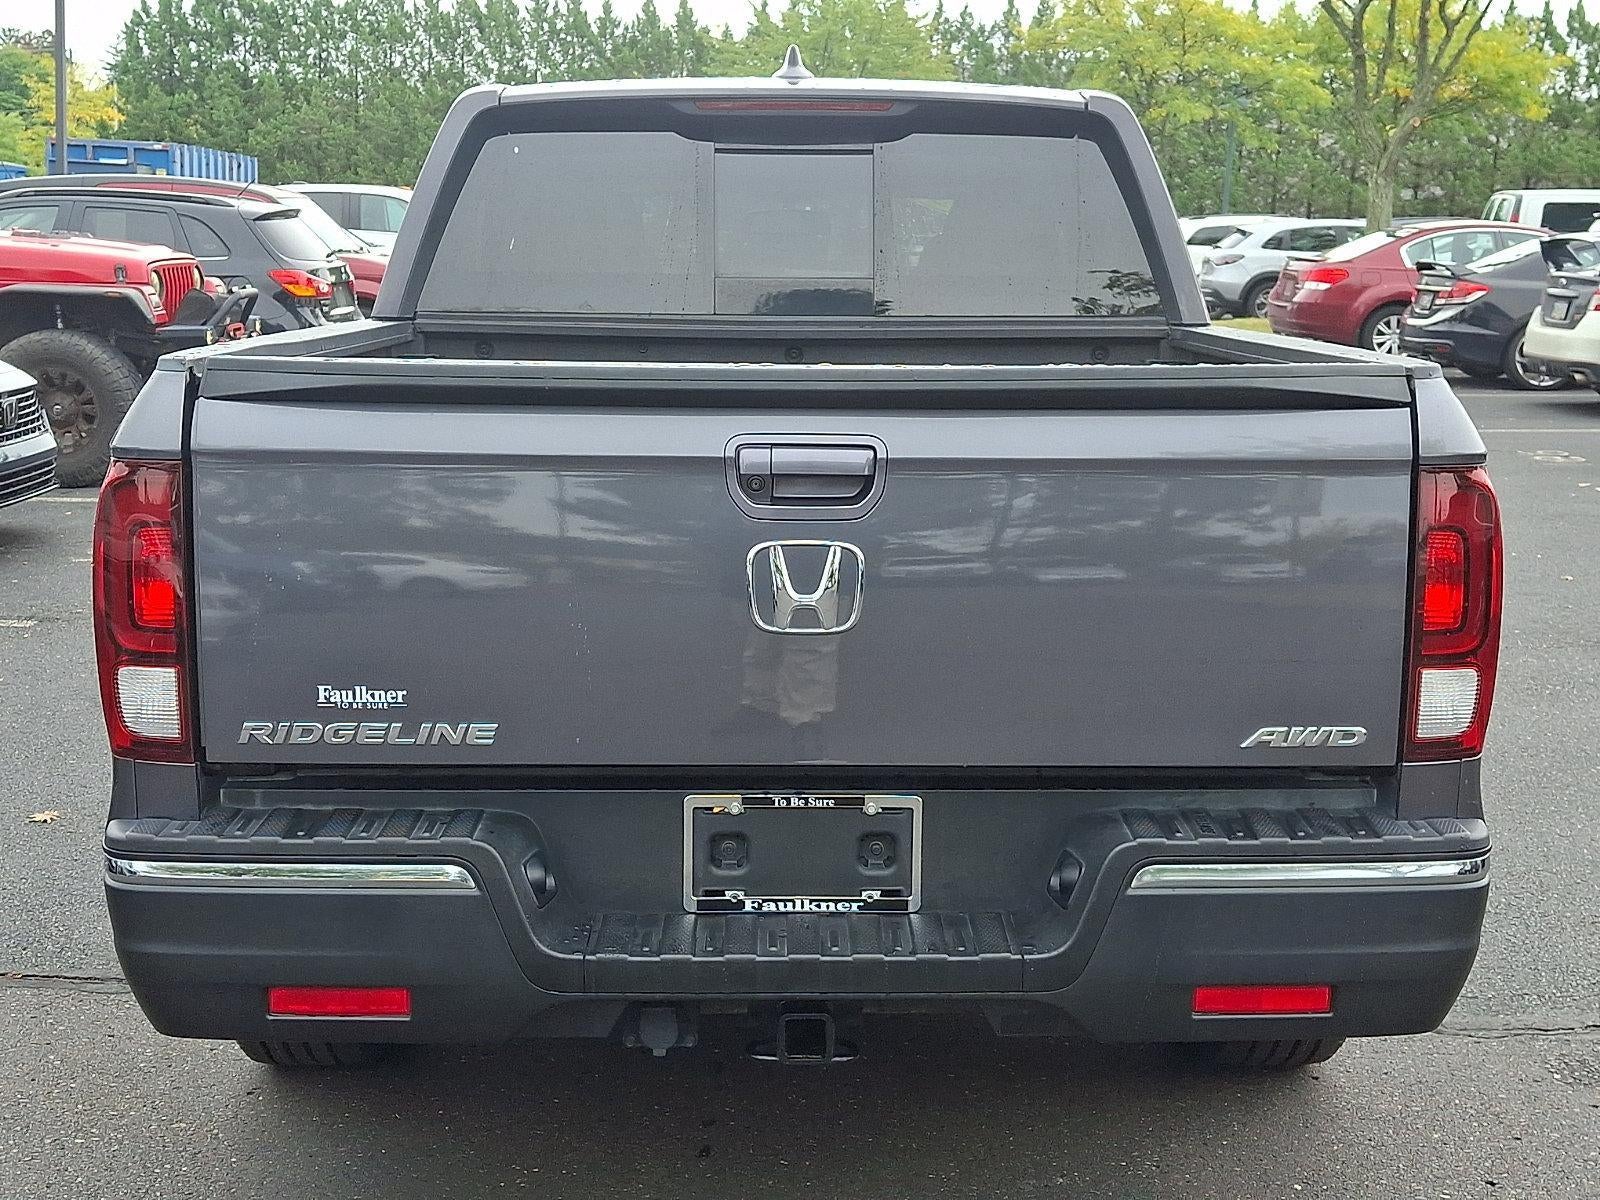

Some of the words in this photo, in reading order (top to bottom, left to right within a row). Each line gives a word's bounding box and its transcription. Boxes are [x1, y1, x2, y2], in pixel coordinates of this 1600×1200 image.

[316, 684, 408, 703] Faulkner
[237, 721, 499, 745] RIDGELINE
[1239, 726, 1368, 748] AWD
[772, 797, 787, 807] To
[790, 797, 805, 807] Be
[808, 797, 835, 807] Sure
[742, 898, 865, 912] Faulkner
